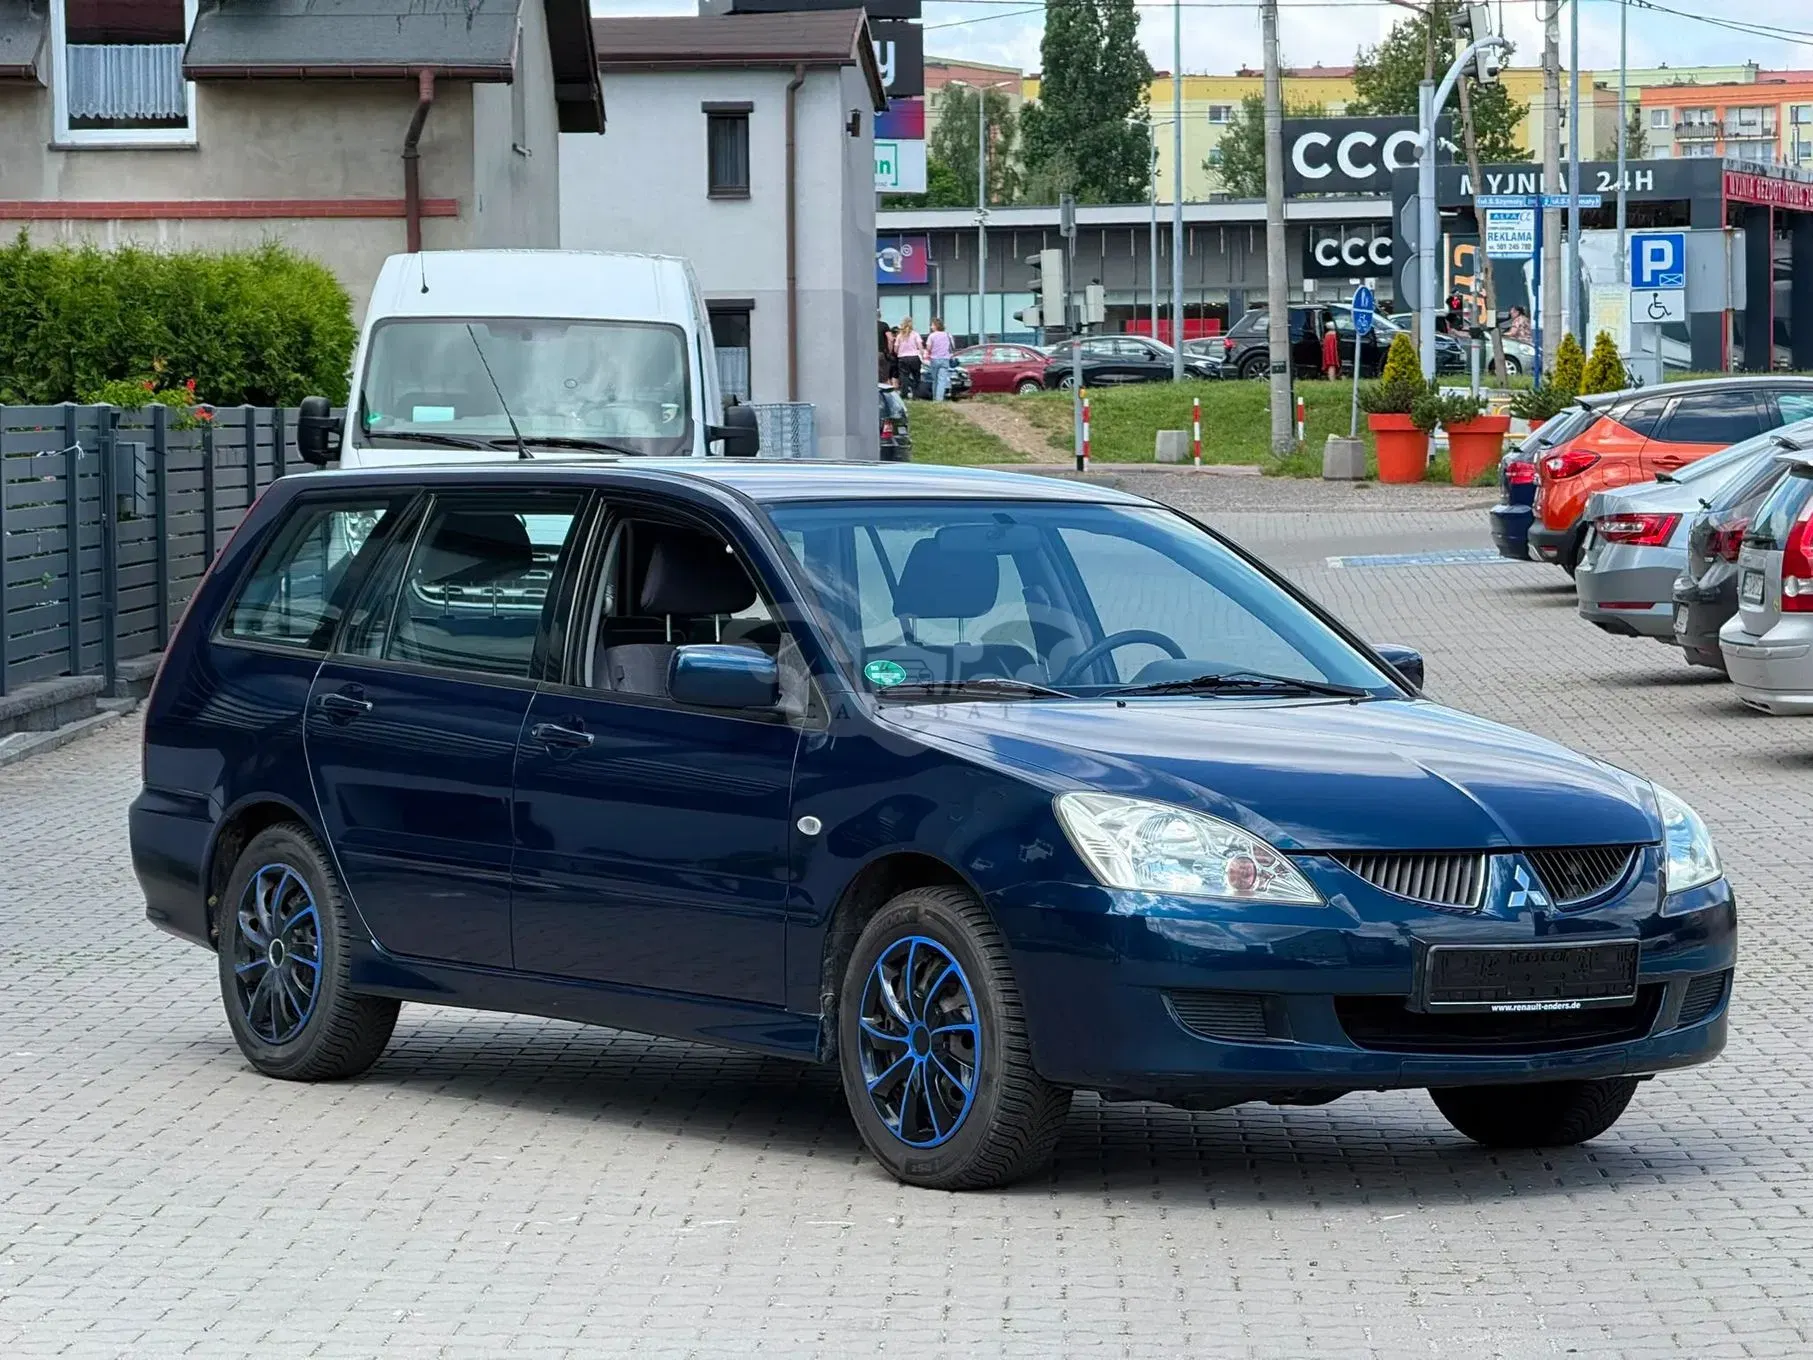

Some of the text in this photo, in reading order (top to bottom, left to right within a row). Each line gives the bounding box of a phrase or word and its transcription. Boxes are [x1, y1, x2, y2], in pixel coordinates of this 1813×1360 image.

[1487, 231, 1532, 242] REKLAMA
[1315, 237, 1394, 267] CCC
[1642, 240, 1674, 283] P
[1491, 1001, 1581, 1012] www.renault-enders.de
